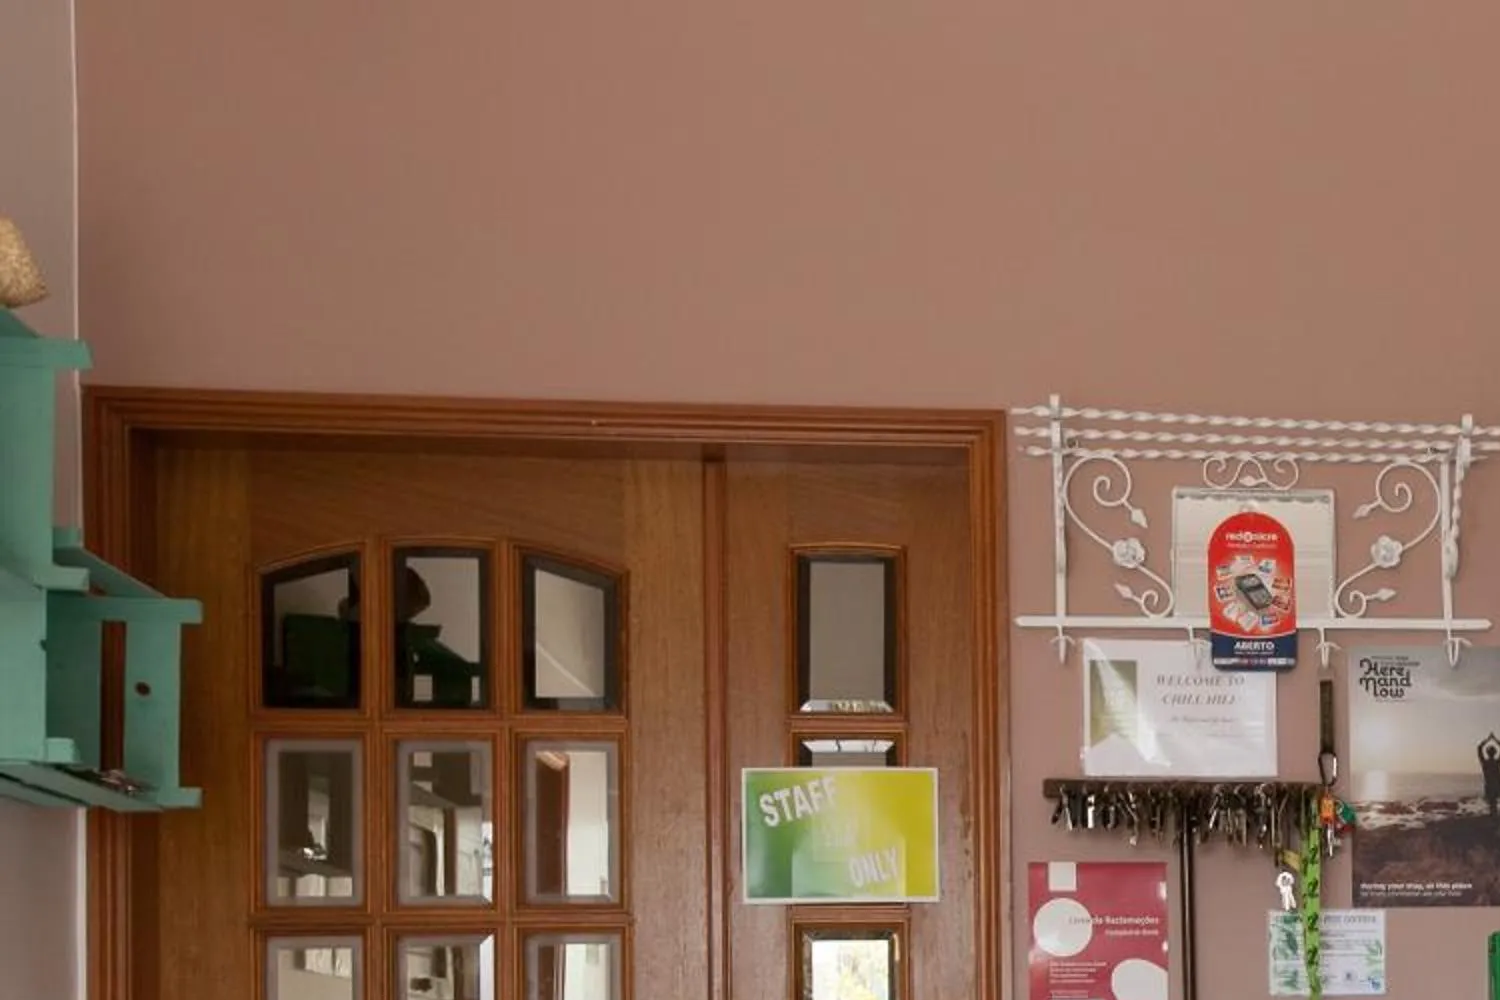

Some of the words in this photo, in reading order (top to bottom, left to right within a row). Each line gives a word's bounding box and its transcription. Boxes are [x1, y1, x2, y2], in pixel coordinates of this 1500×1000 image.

[1233, 641, 1275, 652] ABERTO
[1359, 658, 1405, 676] Here
[1156, 674, 1223, 687] WELCOME
[1228, 674, 1246, 687] TO
[759, 776, 836, 827] STAFF
[850, 847, 898, 888] ONLY
